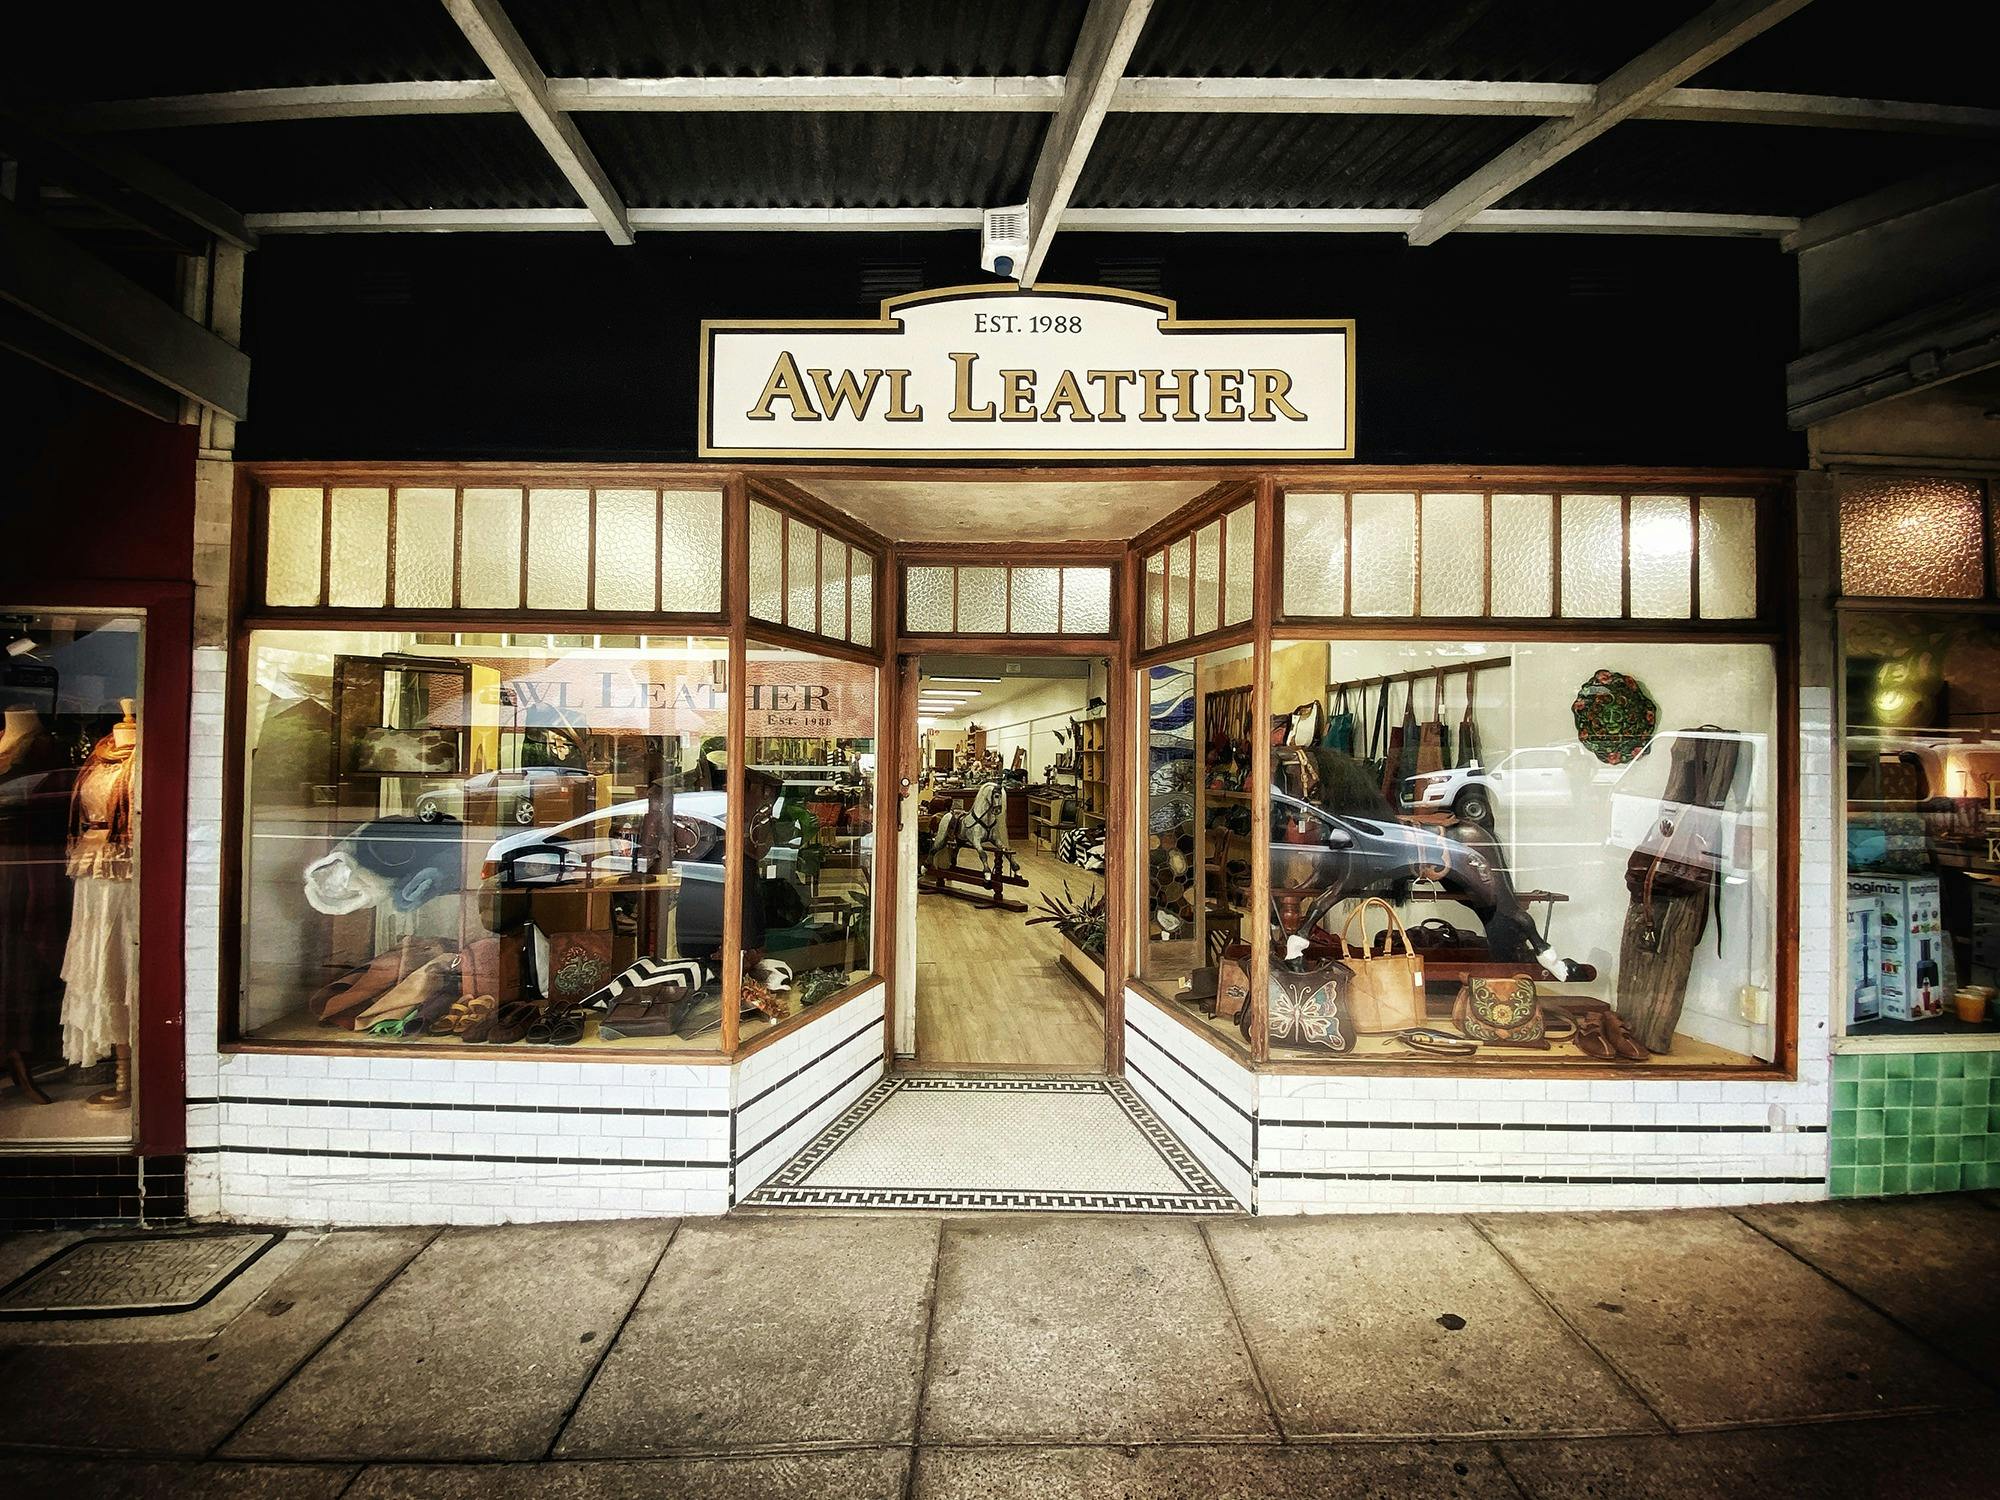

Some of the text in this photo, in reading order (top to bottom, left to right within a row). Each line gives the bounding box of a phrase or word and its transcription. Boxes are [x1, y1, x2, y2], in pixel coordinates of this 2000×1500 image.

[974, 313, 1083, 335] EST. 1988
[746, 350, 1308, 423] AWL LEATHER
[500, 680, 584, 709] WL
